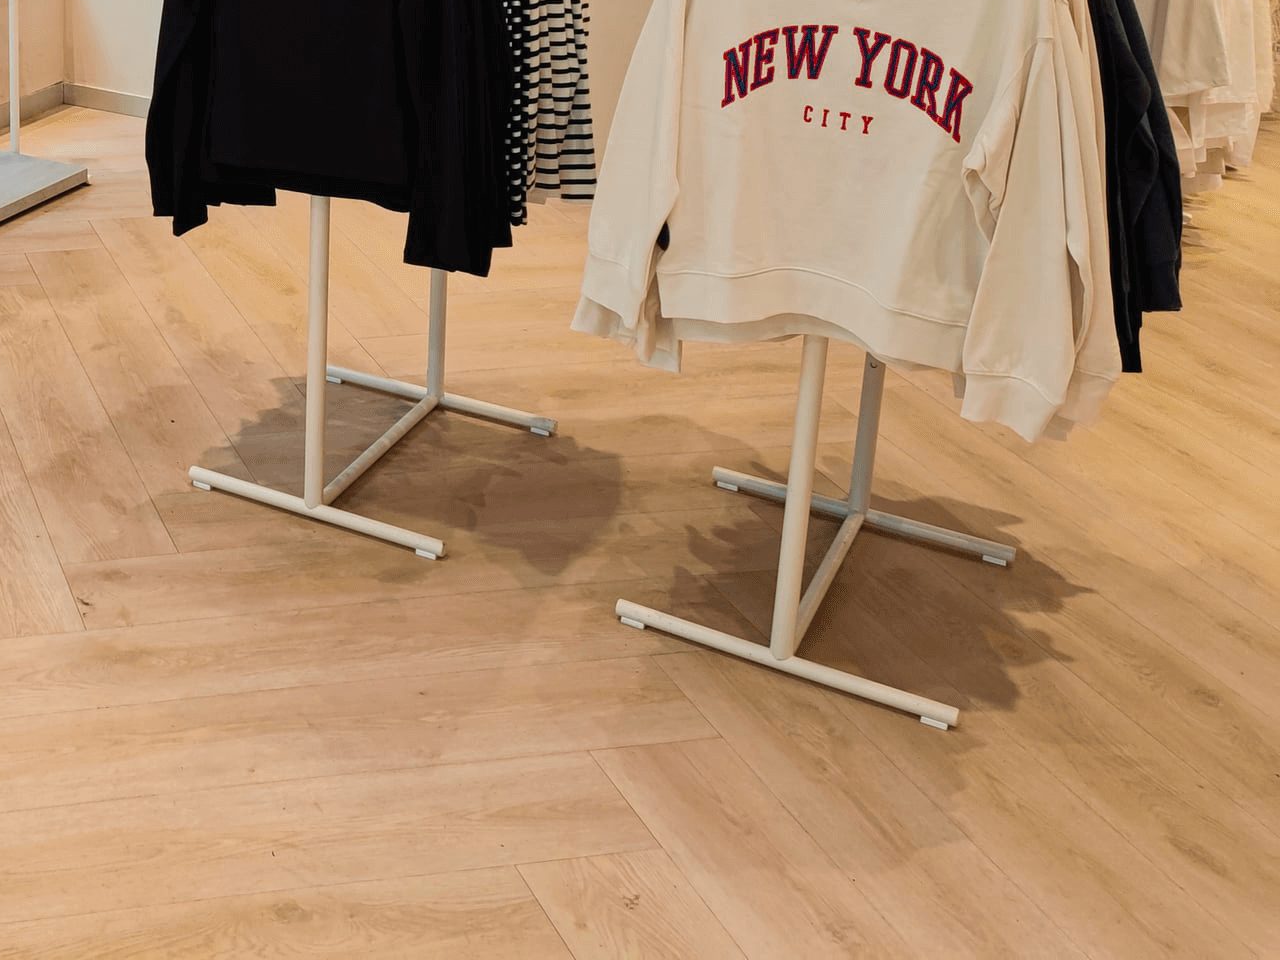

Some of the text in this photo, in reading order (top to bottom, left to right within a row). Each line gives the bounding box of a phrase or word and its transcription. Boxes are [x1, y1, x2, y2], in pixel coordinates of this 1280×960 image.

[721, 24, 974, 144] NEW YORK
[803, 105, 874, 135] CITY
